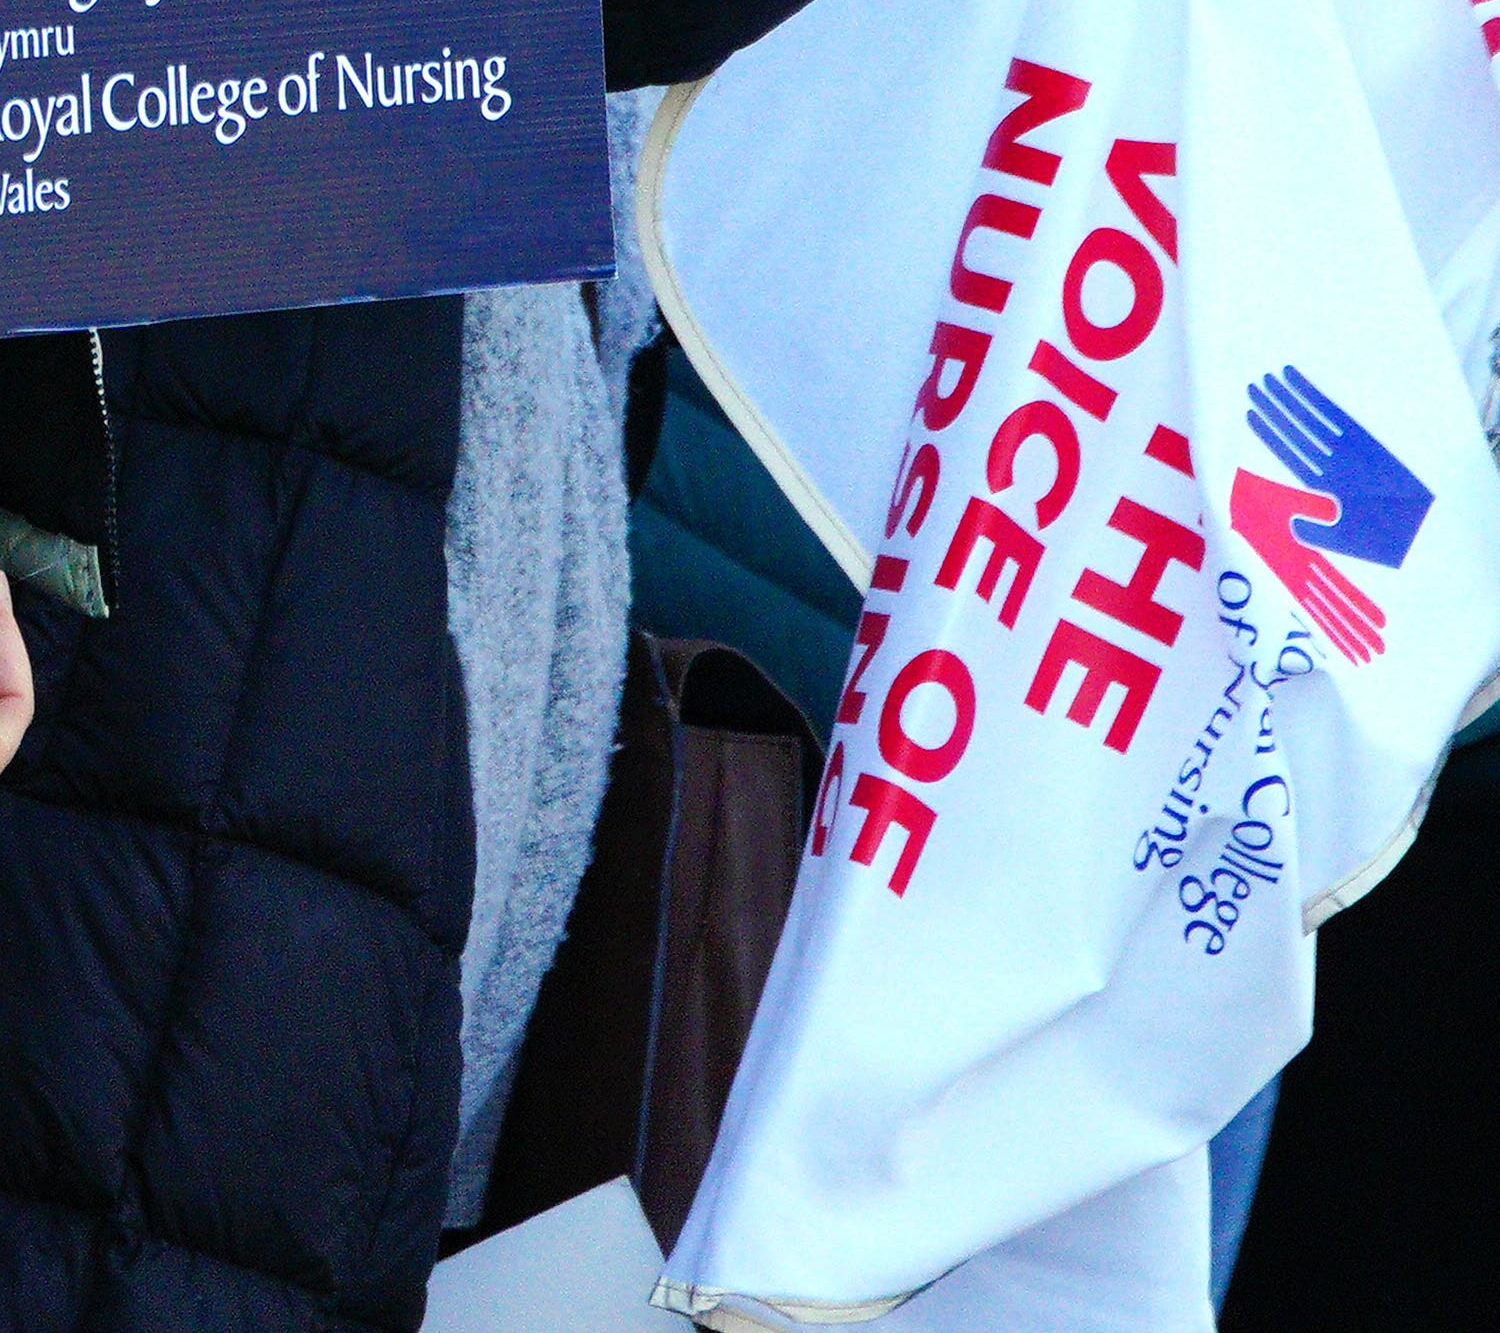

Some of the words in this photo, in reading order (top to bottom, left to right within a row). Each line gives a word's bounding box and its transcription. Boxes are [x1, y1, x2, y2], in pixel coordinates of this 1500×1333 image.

[102, 66, 267, 143] College
[279, 53, 324, 114] of
[336, 53, 511, 120] Nursing
[1025, 425, 1205, 752] HE
[1217, 571, 1257, 646] of
[851, 650, 975, 896] OF
[1178, 775, 1289, 954] College
